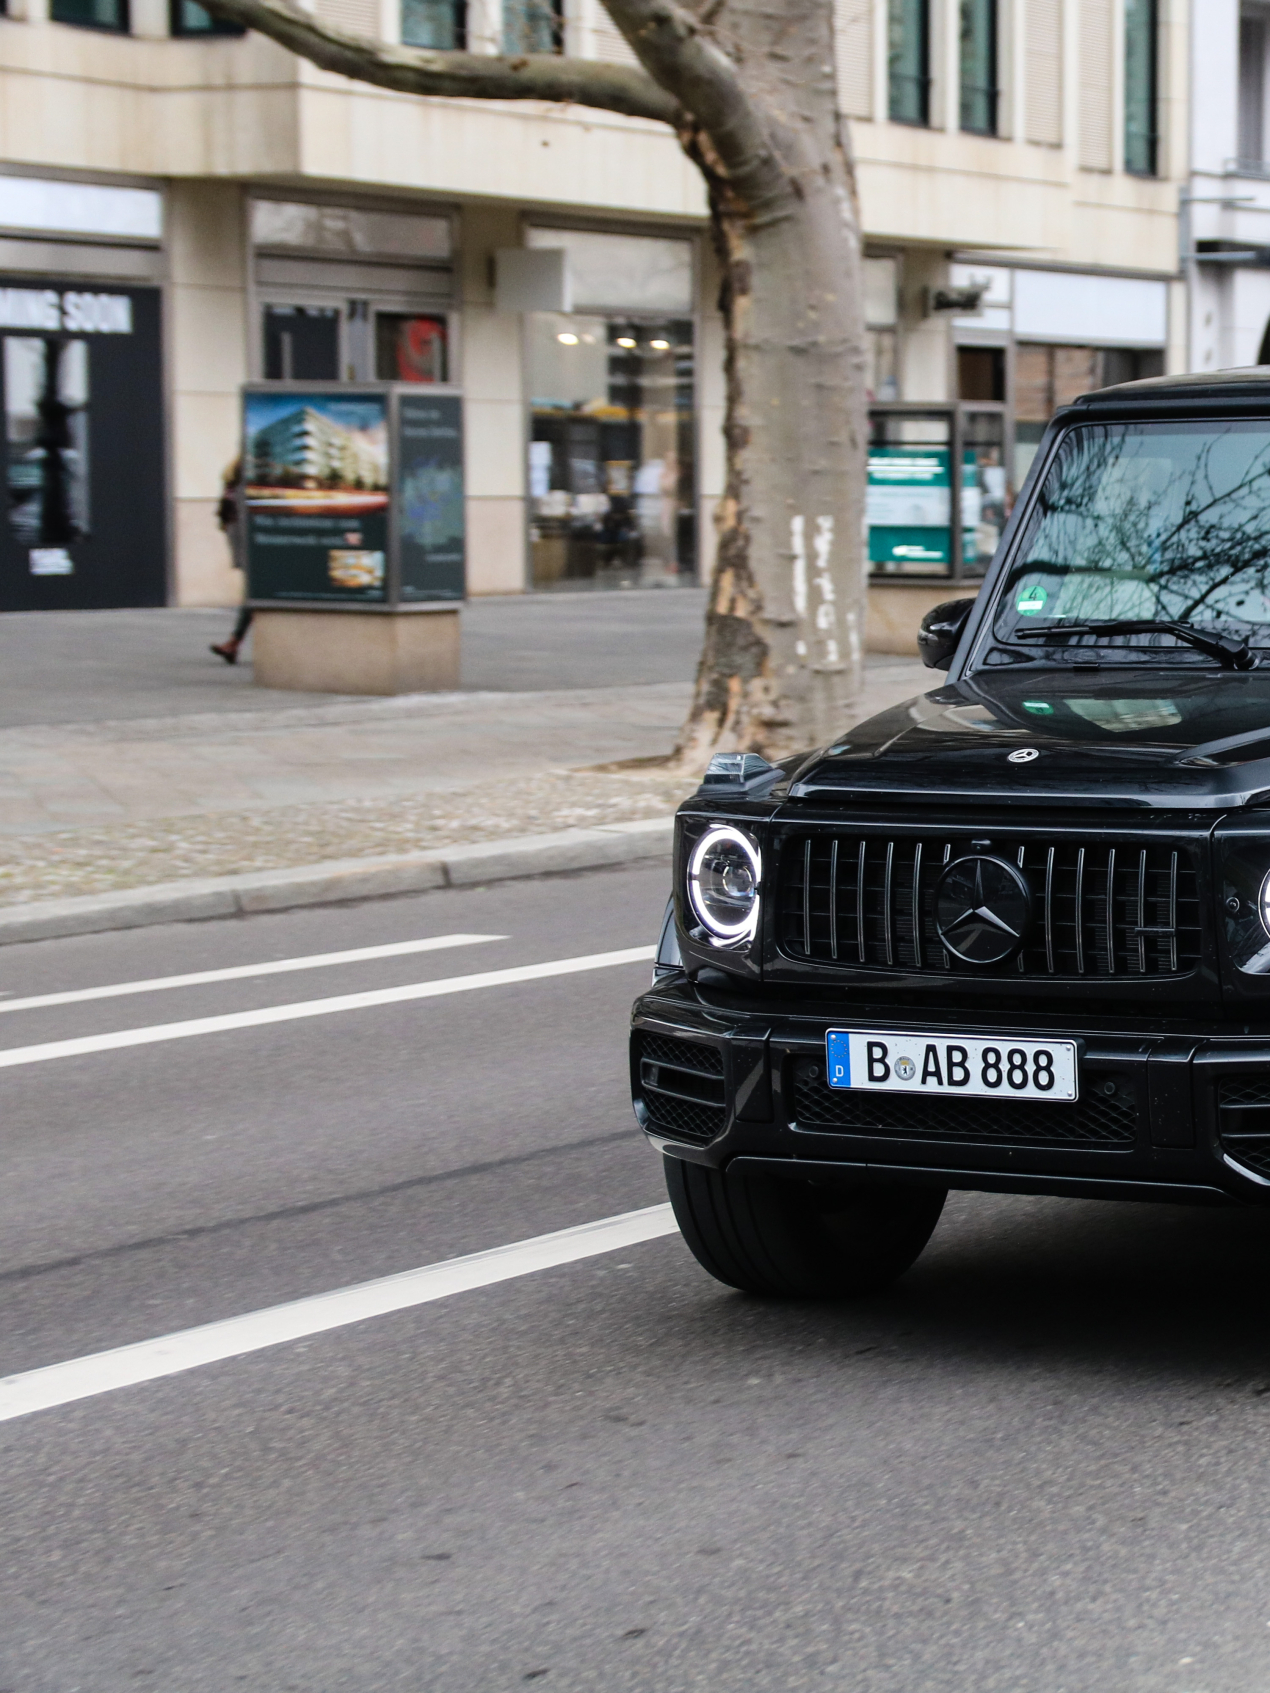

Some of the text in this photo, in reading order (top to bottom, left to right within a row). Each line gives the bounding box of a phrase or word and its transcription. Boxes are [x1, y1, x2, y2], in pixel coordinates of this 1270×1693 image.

[62, 291, 133, 335] SOON
[1028, 586, 1037, 601] 4
[835, 1065, 845, 1077] D
[866, 1040, 891, 1083] B
[920, 1043, 971, 1087] AB
[981, 1046, 1055, 1090] 888
